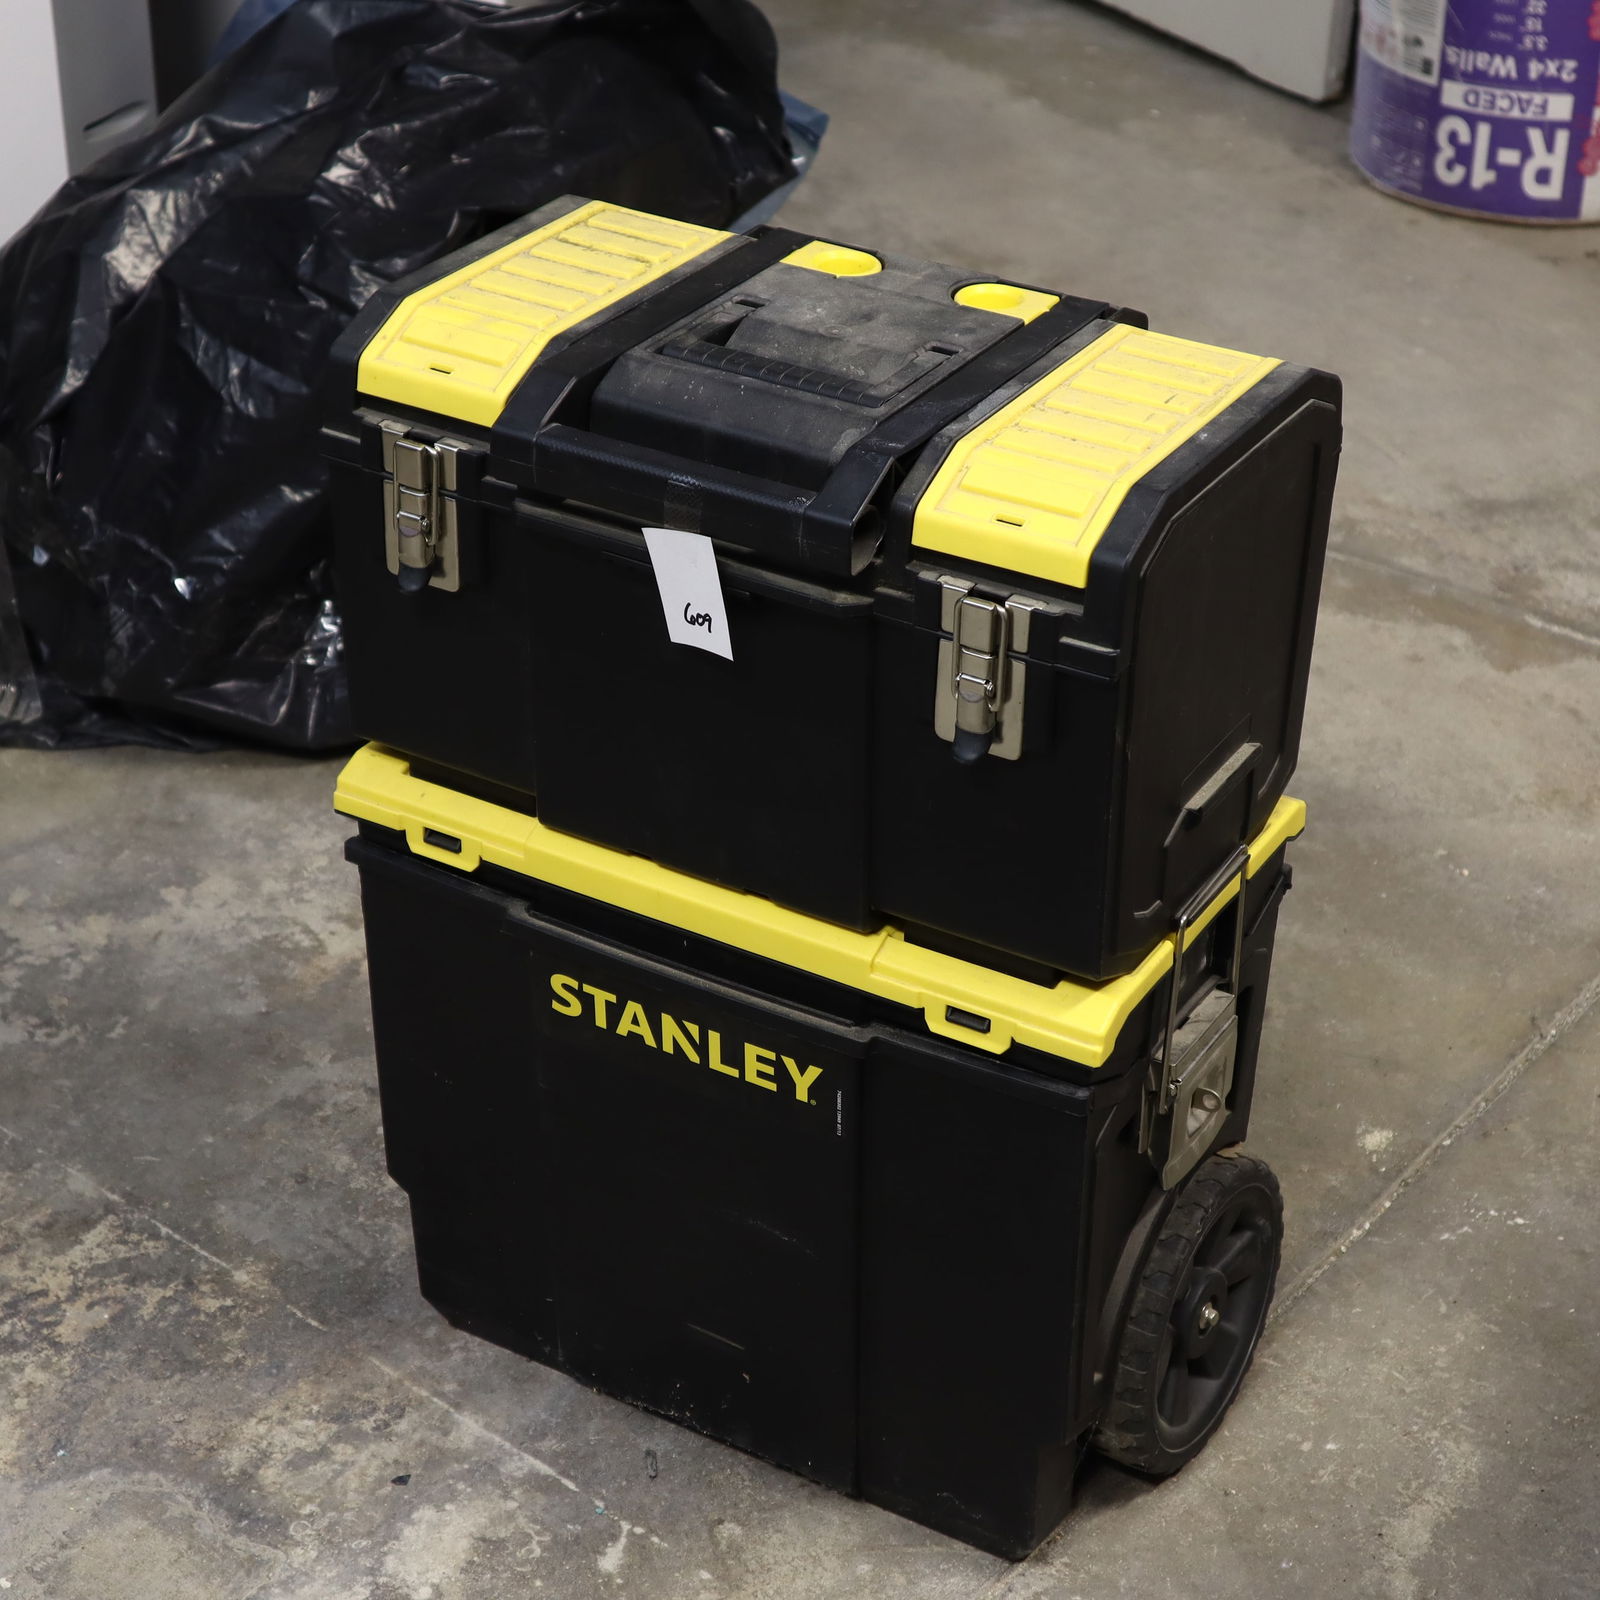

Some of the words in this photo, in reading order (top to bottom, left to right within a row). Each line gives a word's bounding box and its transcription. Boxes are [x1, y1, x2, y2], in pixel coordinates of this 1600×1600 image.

[1444, 45, 1518, 80] Walls
[1528, 58, 1578, 82] 2x4
[1463, 88, 1548, 116] FACED
[1433, 115, 1571, 200] R-13
[683, 602, 712, 633] 609
[549, 973, 824, 1104] STANLEY
